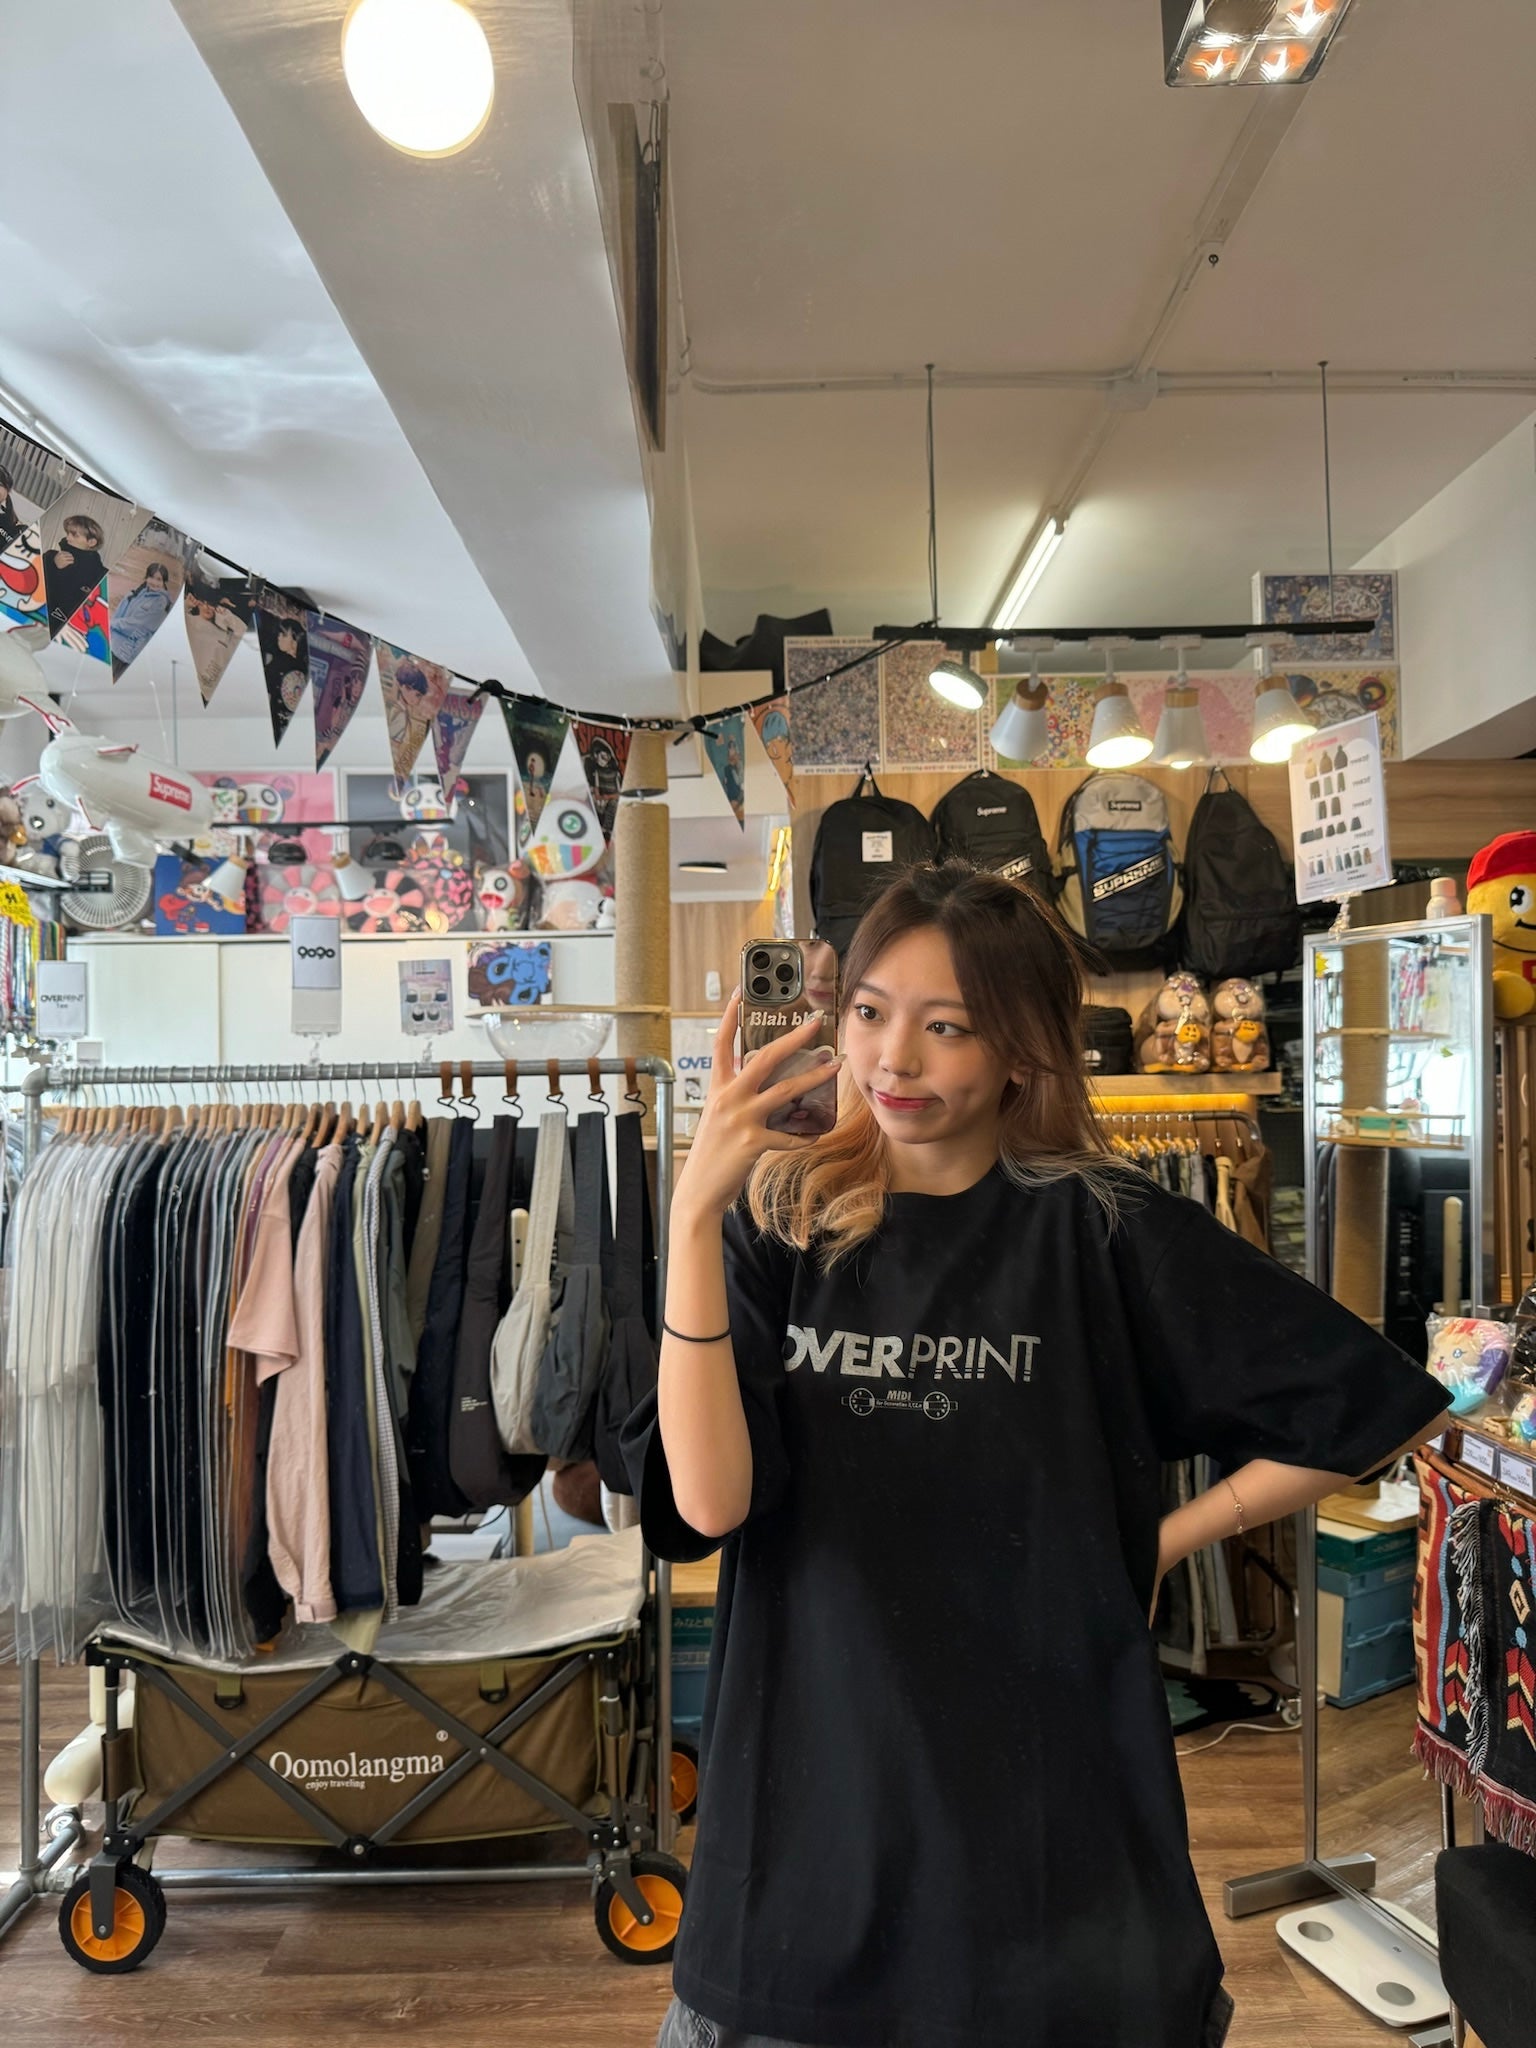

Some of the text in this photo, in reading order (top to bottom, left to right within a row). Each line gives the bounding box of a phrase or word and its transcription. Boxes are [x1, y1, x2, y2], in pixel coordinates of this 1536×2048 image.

[749, 1011, 788, 1026] Blah
[678, 1056, 712, 1070] OVE
[886, 1389, 912, 1401] MIDI
[269, 1751, 446, 1783] Qomolangma
[305, 1778, 366, 1791] enjoy traveling
